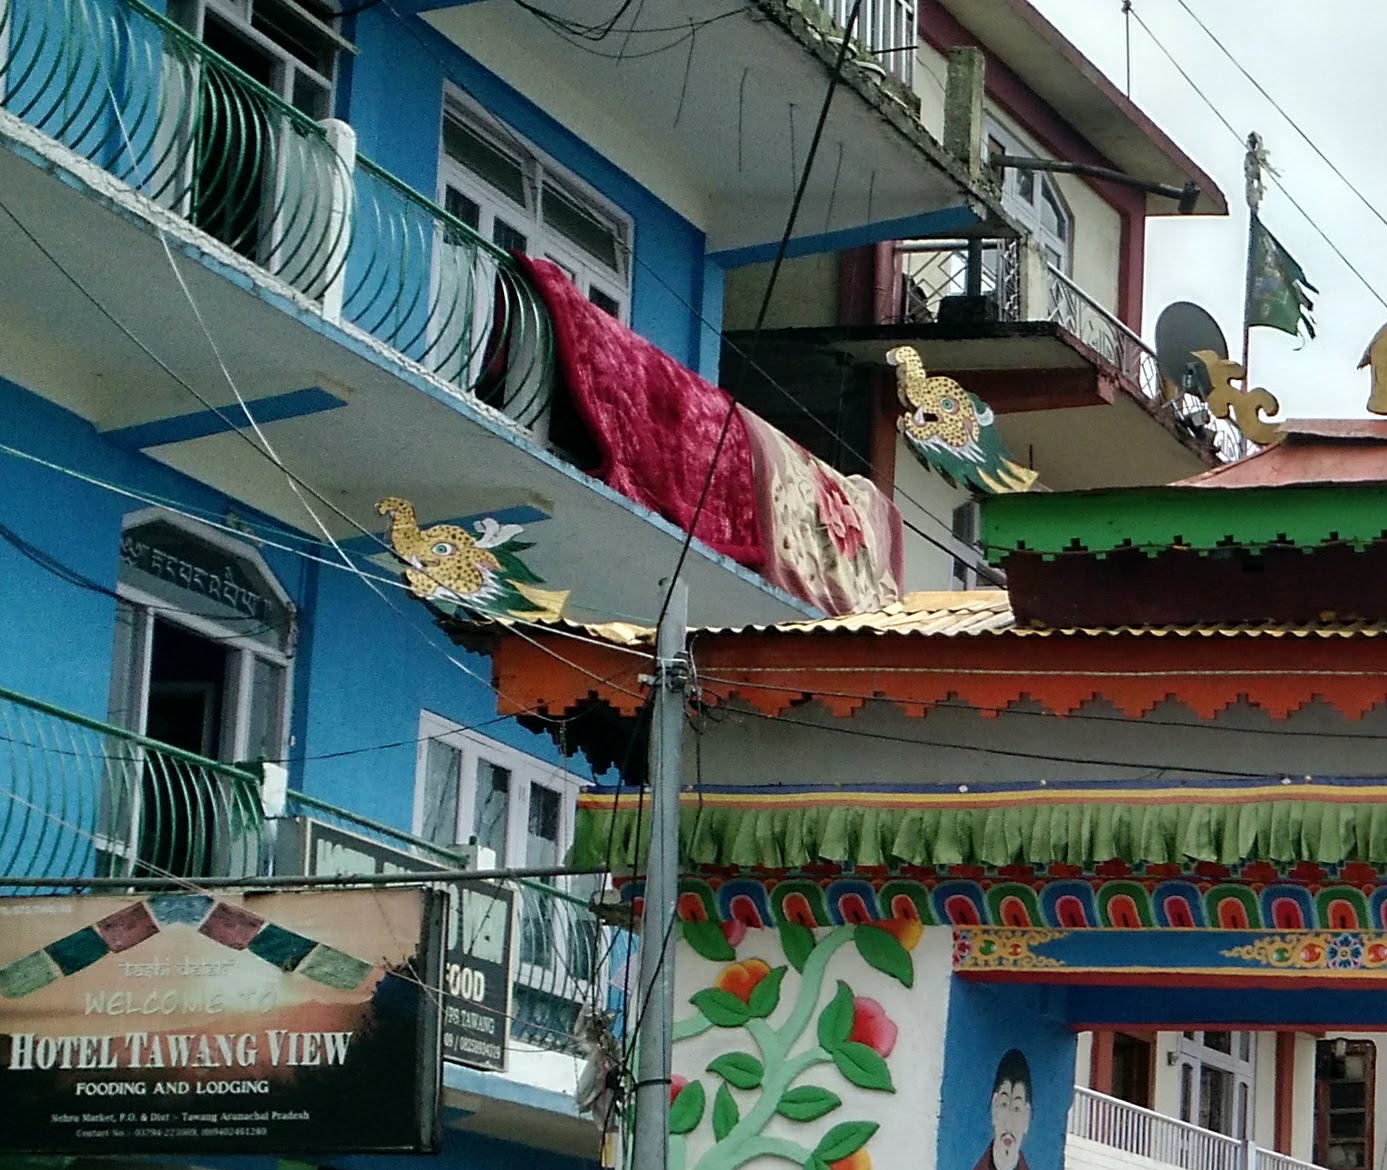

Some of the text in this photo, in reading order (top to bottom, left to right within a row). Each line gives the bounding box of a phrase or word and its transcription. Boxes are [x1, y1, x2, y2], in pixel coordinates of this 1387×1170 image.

[446, 963, 485, 1003] OOD
[84, 989, 276, 1015] WELCOME TO
[8, 1030, 353, 1070] HOTEL TAWANG VIEW
[75, 1080, 269, 1096] FOODING AND LODGING
[141, 1112, 148, 1122] &
[182, 1112, 217, 1122] Tawang
[220, 1111, 269, 1121] Arunachal
[271, 1110, 310, 1120] Pradesh
